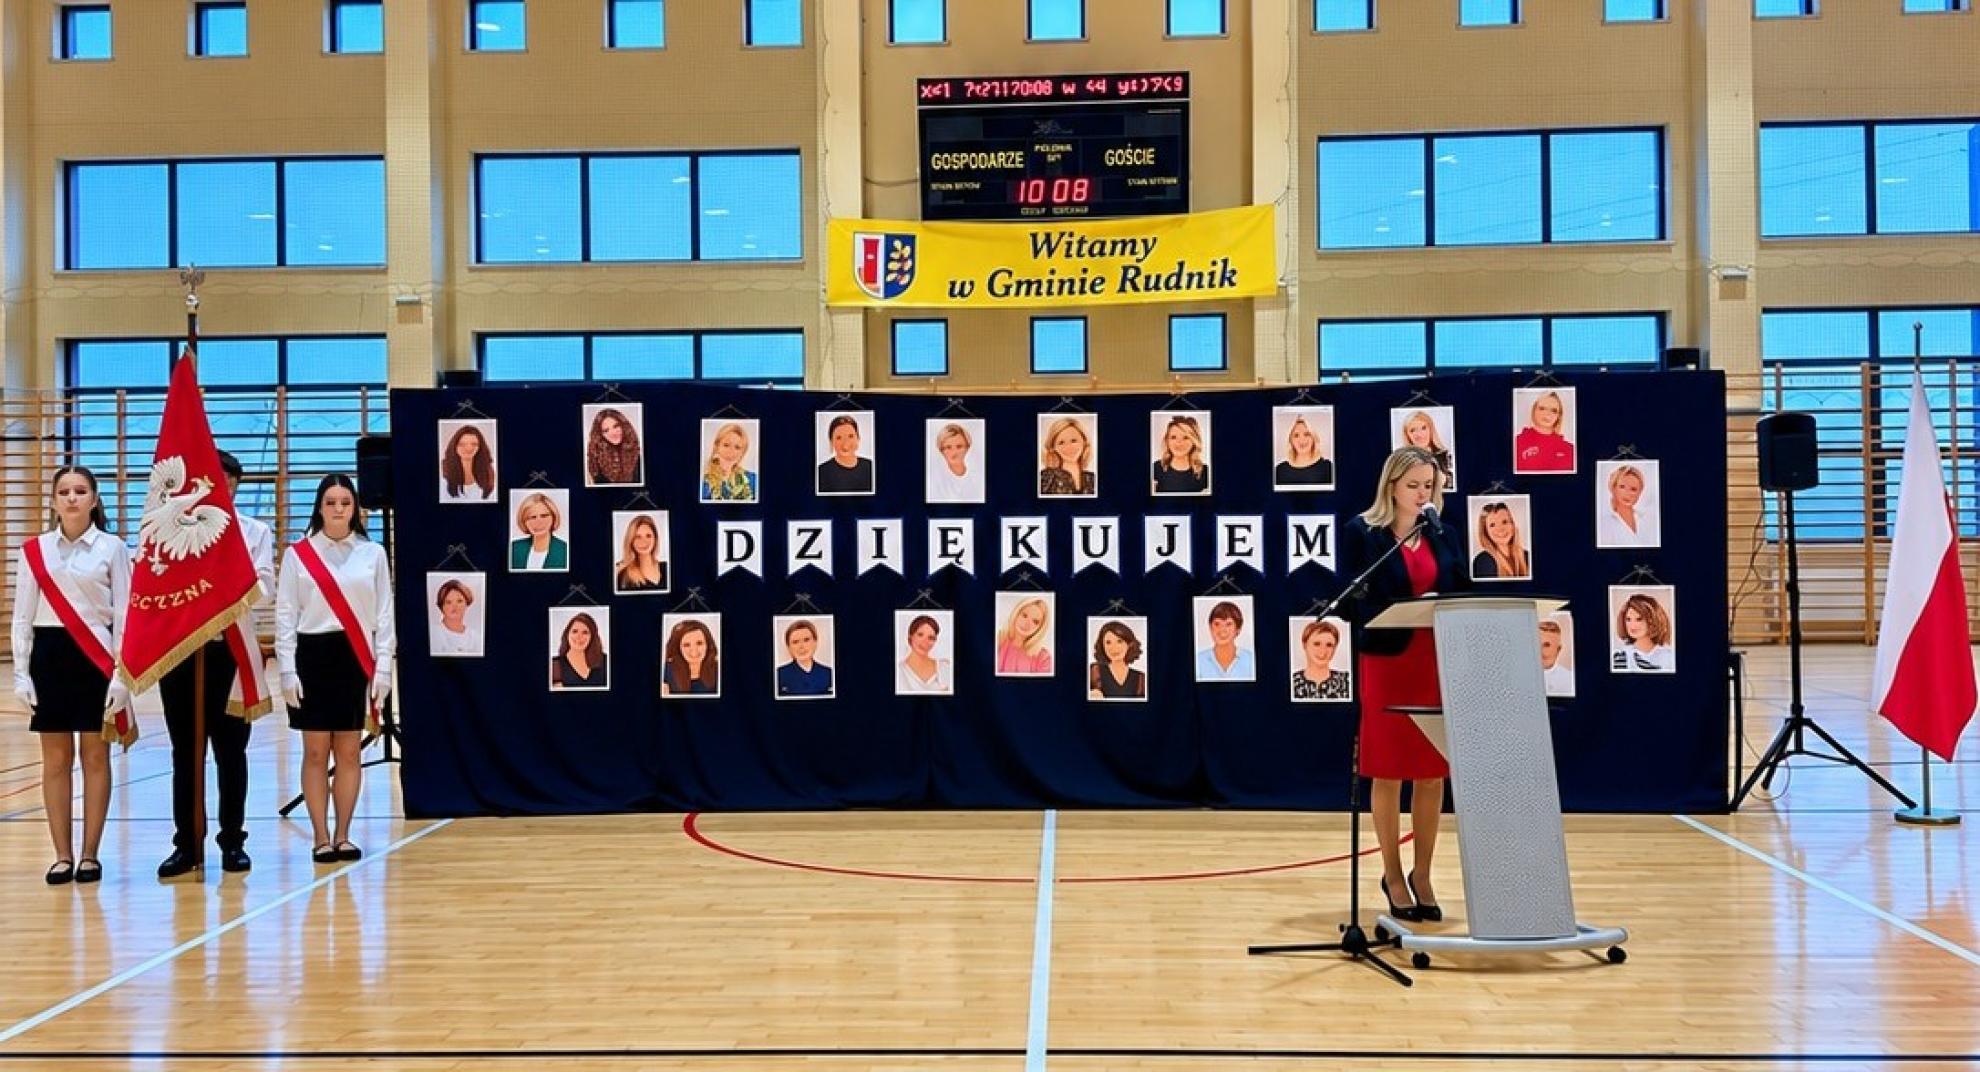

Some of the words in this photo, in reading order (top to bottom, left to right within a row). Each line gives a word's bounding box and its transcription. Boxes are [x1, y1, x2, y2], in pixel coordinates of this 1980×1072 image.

[931, 150, 1025, 170] GOSPODARZE
[1104, 143, 1155, 167] GOŚCIE
[1028, 231, 1157, 262] Witamy
[948, 280, 974, 298] w
[987, 268, 1106, 299] Gminie
[1118, 258, 1238, 294] Rudnik
